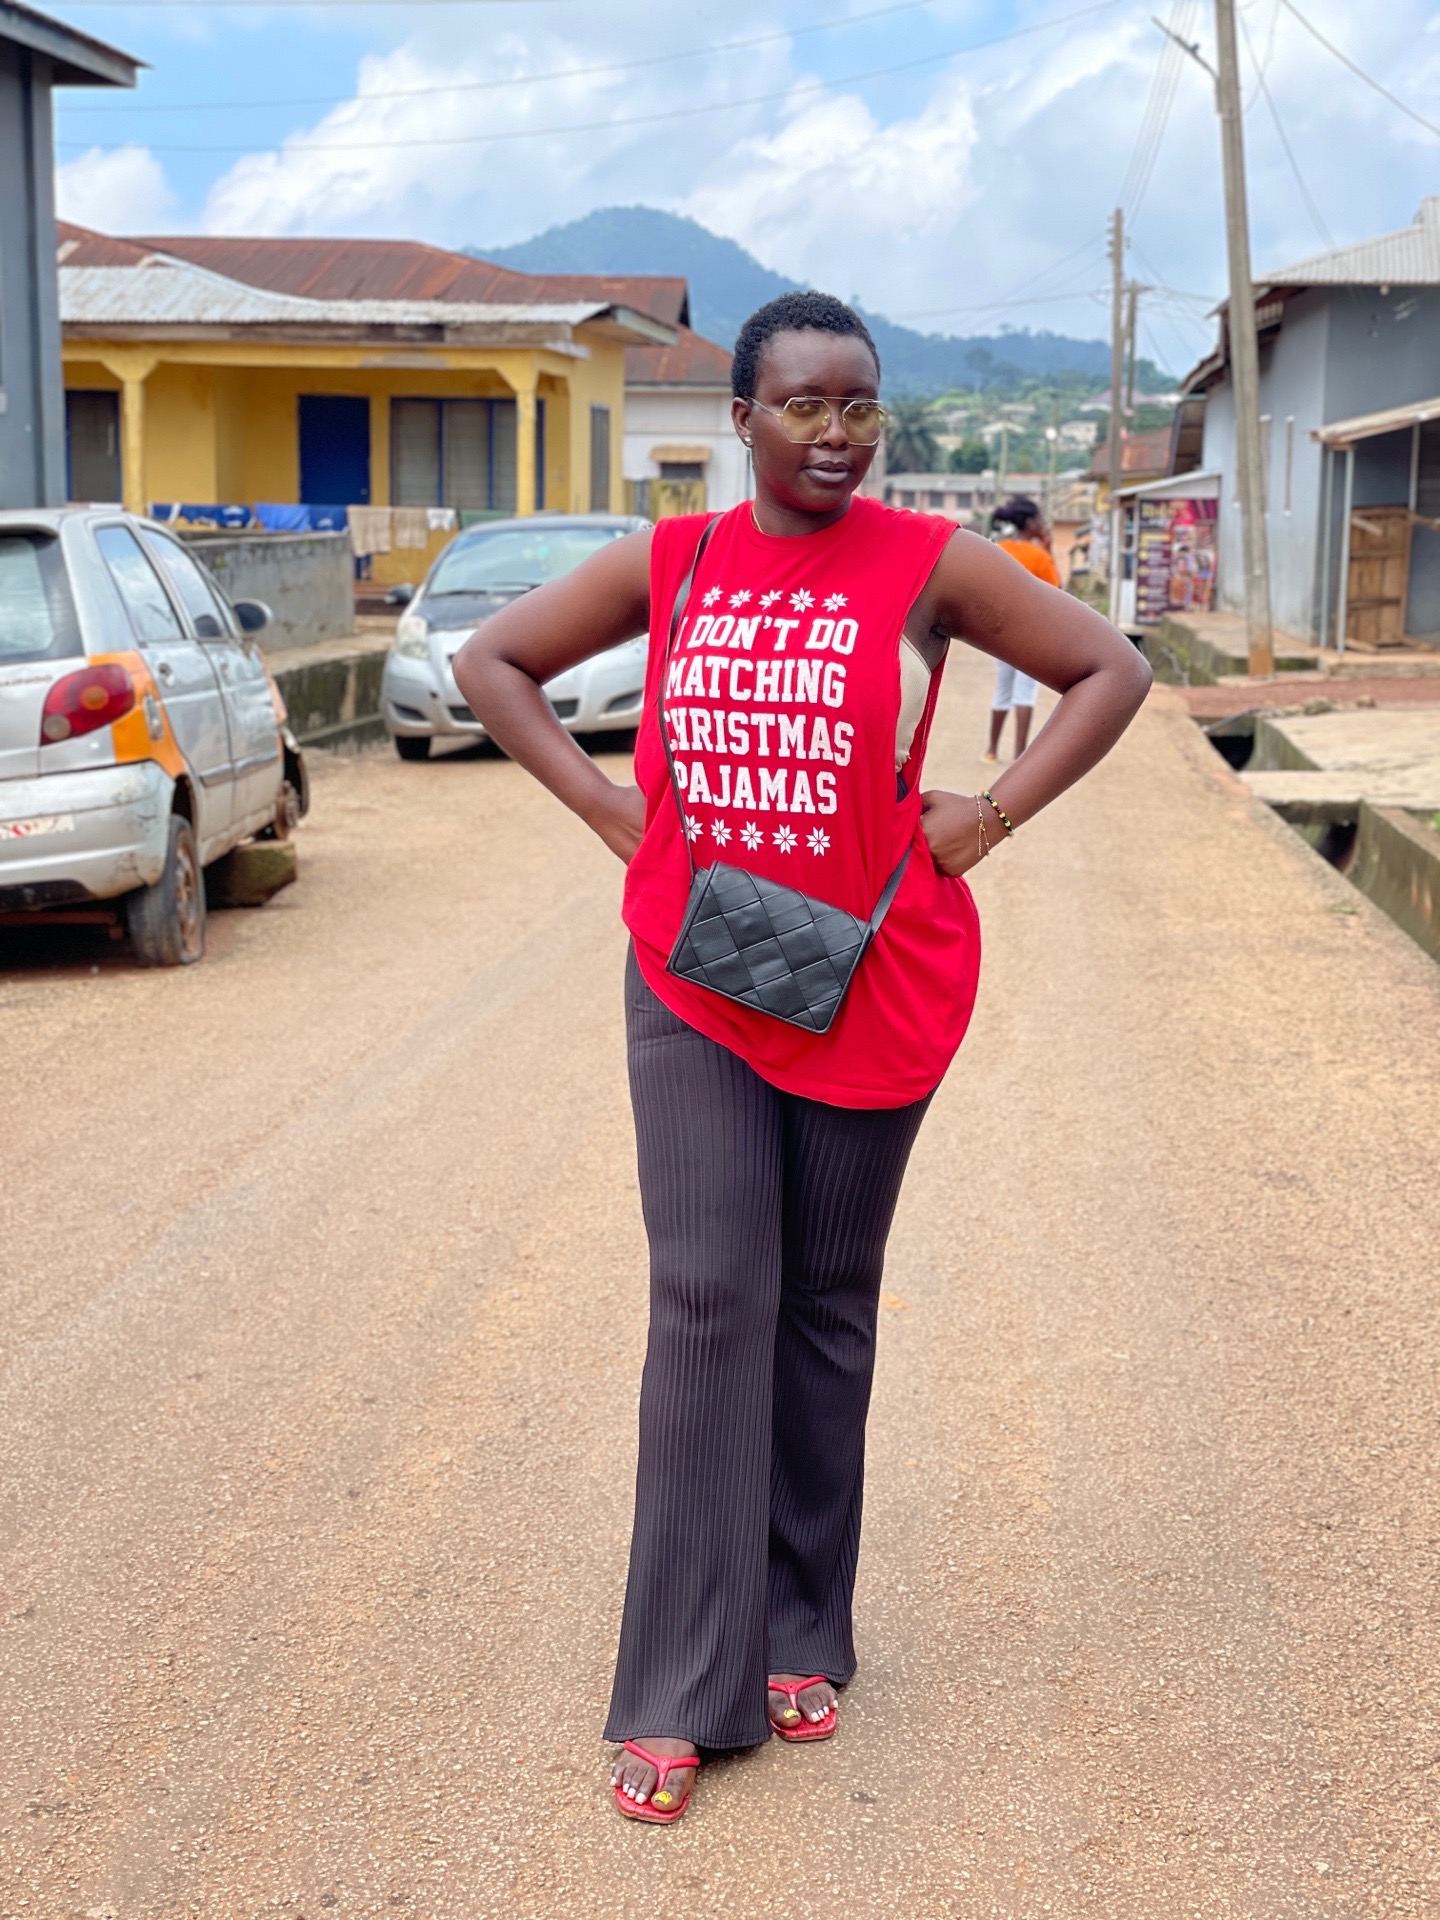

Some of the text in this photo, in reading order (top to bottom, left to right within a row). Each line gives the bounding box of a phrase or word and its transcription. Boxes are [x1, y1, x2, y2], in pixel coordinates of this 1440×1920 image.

[673, 614, 859, 656] I DON'T DO
[665, 655, 847, 708] MATCHING
[674, 760, 838, 815] PAJAMAS
